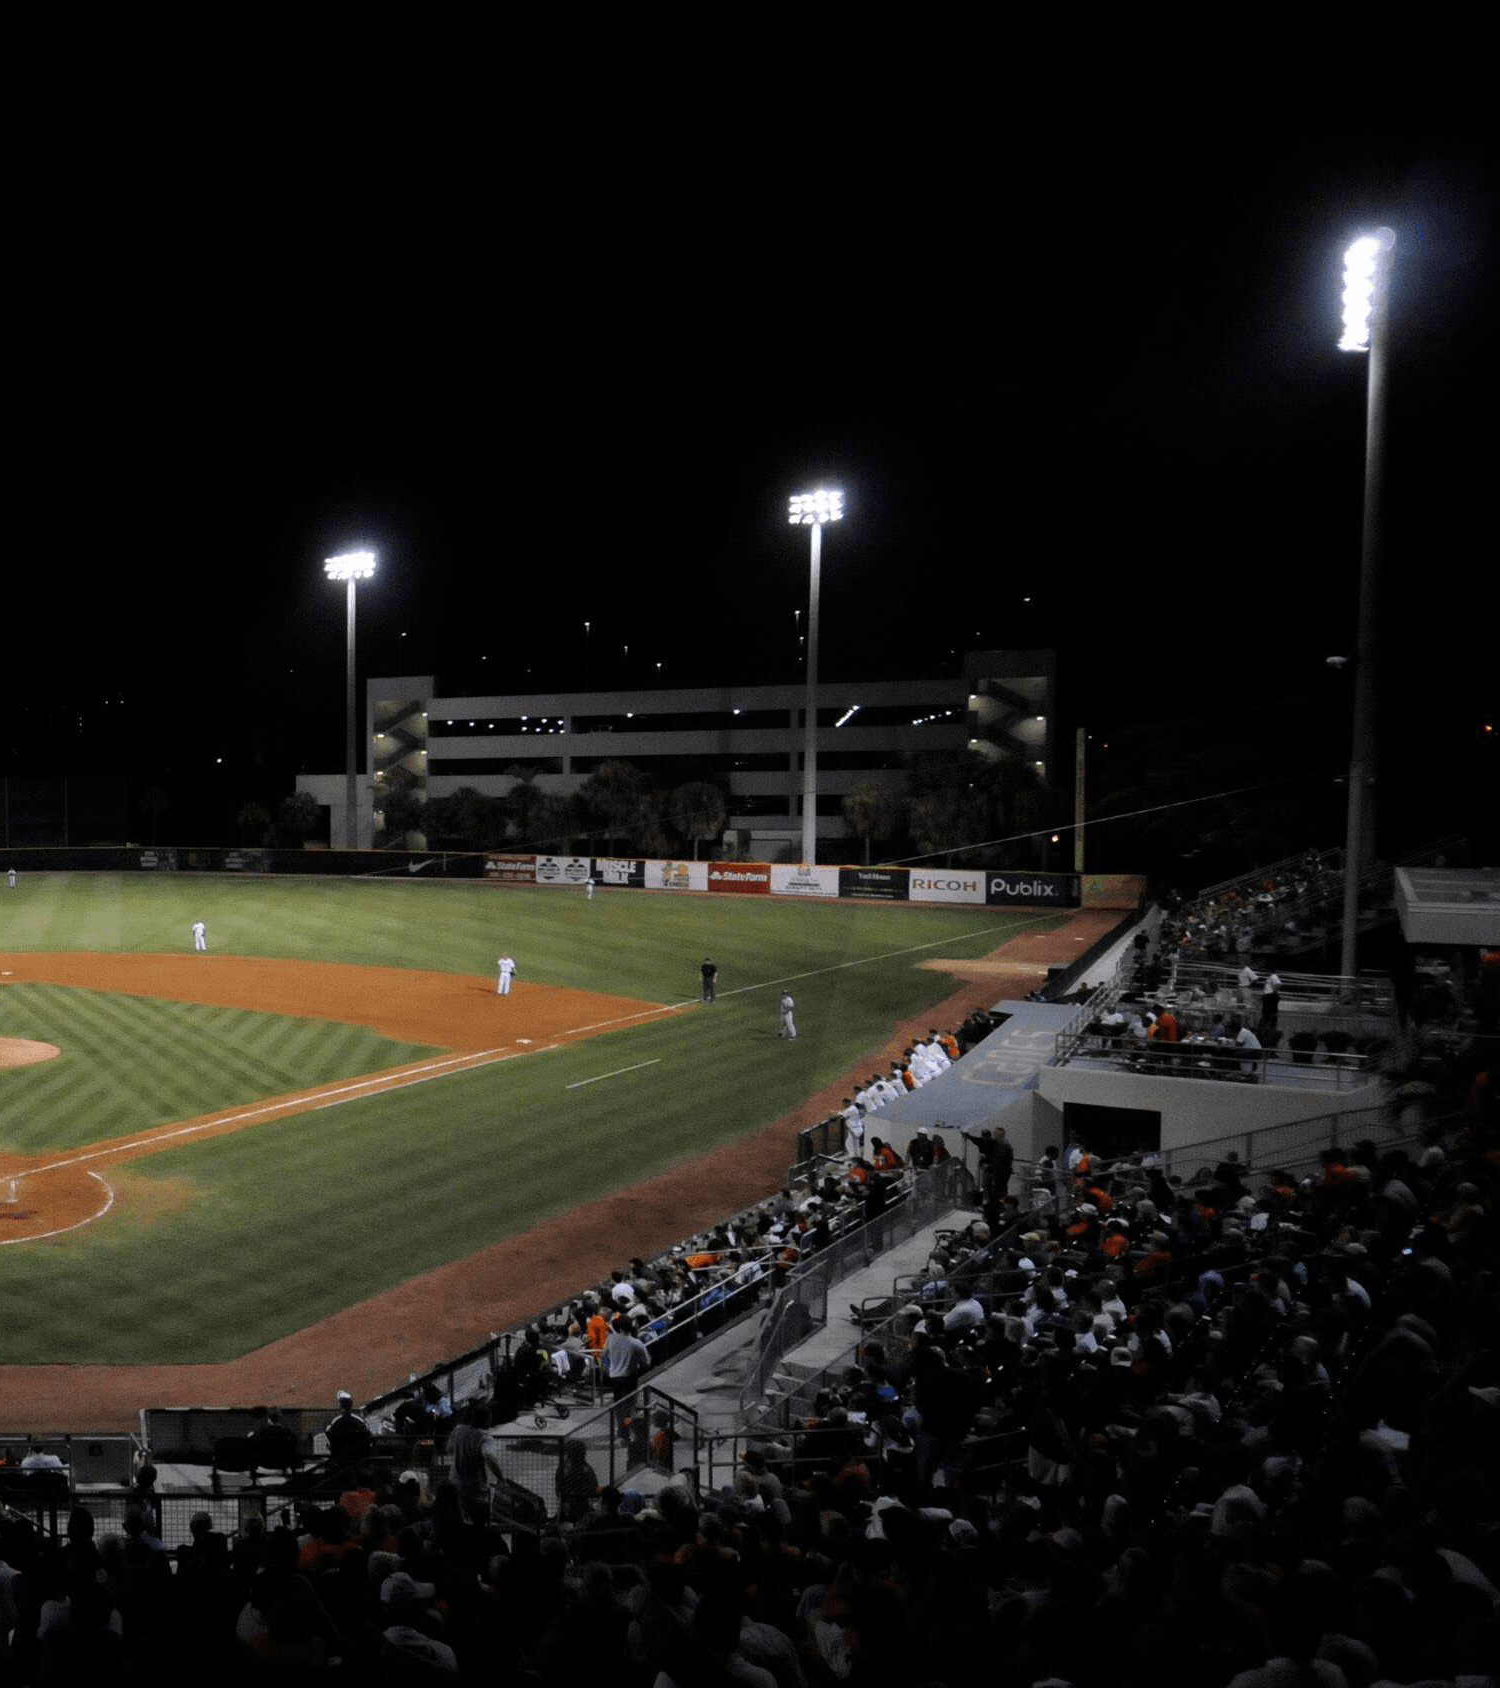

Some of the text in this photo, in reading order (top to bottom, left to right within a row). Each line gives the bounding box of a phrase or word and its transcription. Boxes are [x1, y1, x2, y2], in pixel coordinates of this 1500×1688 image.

[596, 859, 636, 873] MUSCLE
[603, 869, 629, 884] MILK
[913, 879, 977, 891] RICOH
[991, 878, 1055, 897] Publix
